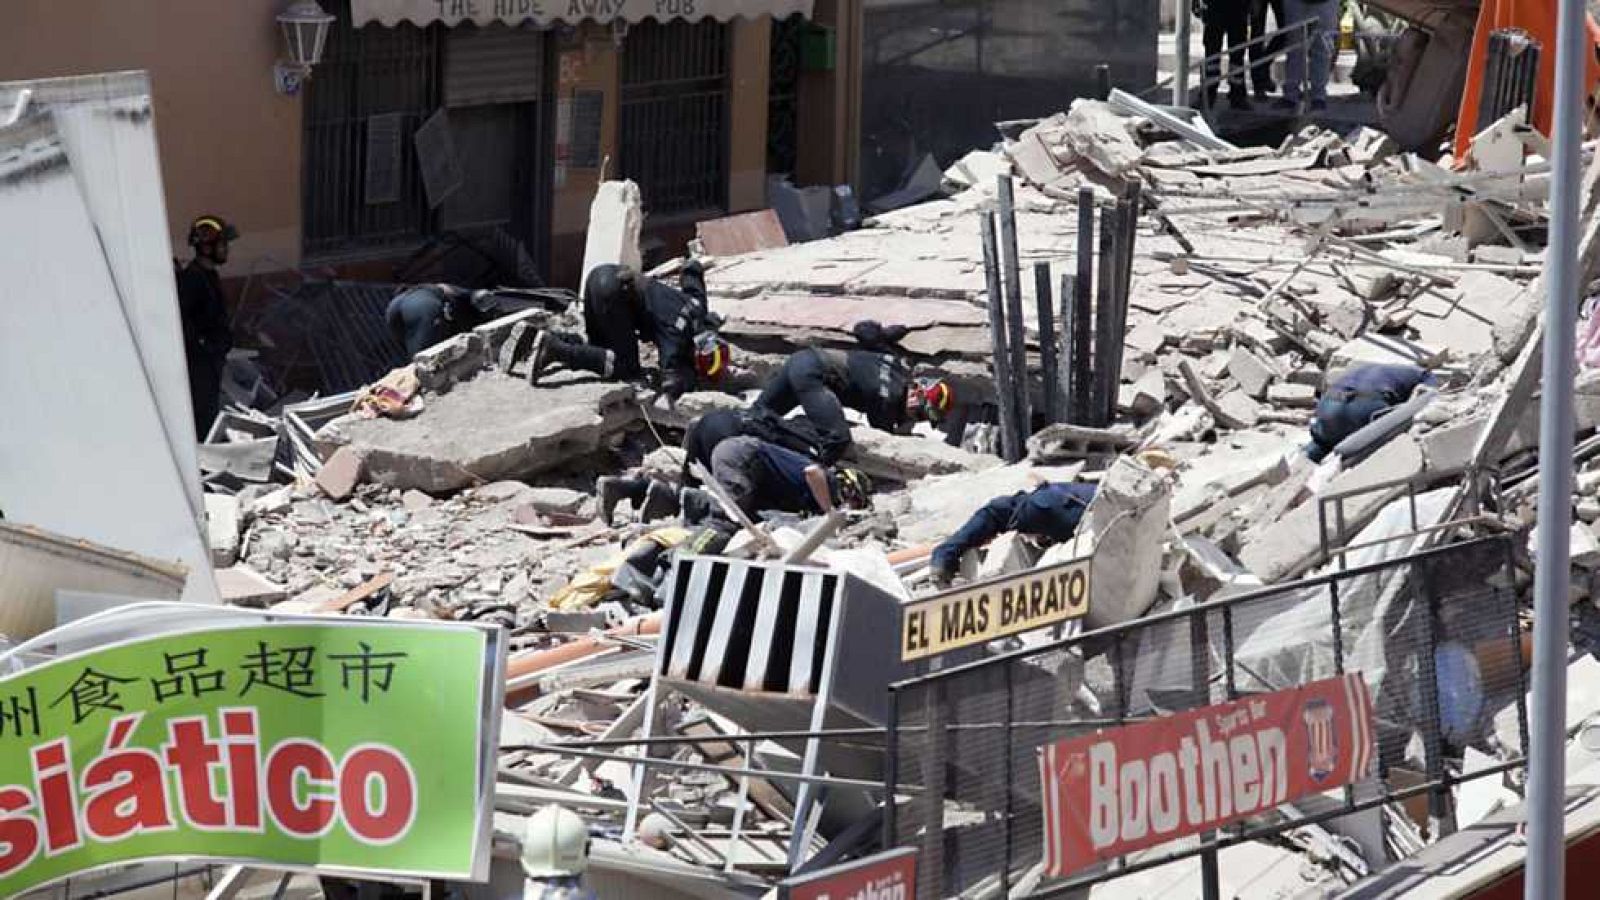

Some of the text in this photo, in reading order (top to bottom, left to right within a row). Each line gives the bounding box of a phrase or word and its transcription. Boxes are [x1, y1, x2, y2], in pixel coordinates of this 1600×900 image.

[436, 0, 695, 16] THE HIDE AWAY PUB
[906, 568, 1086, 651] EL MAS BARATO
[1088, 718, 1288, 851] Boothen
